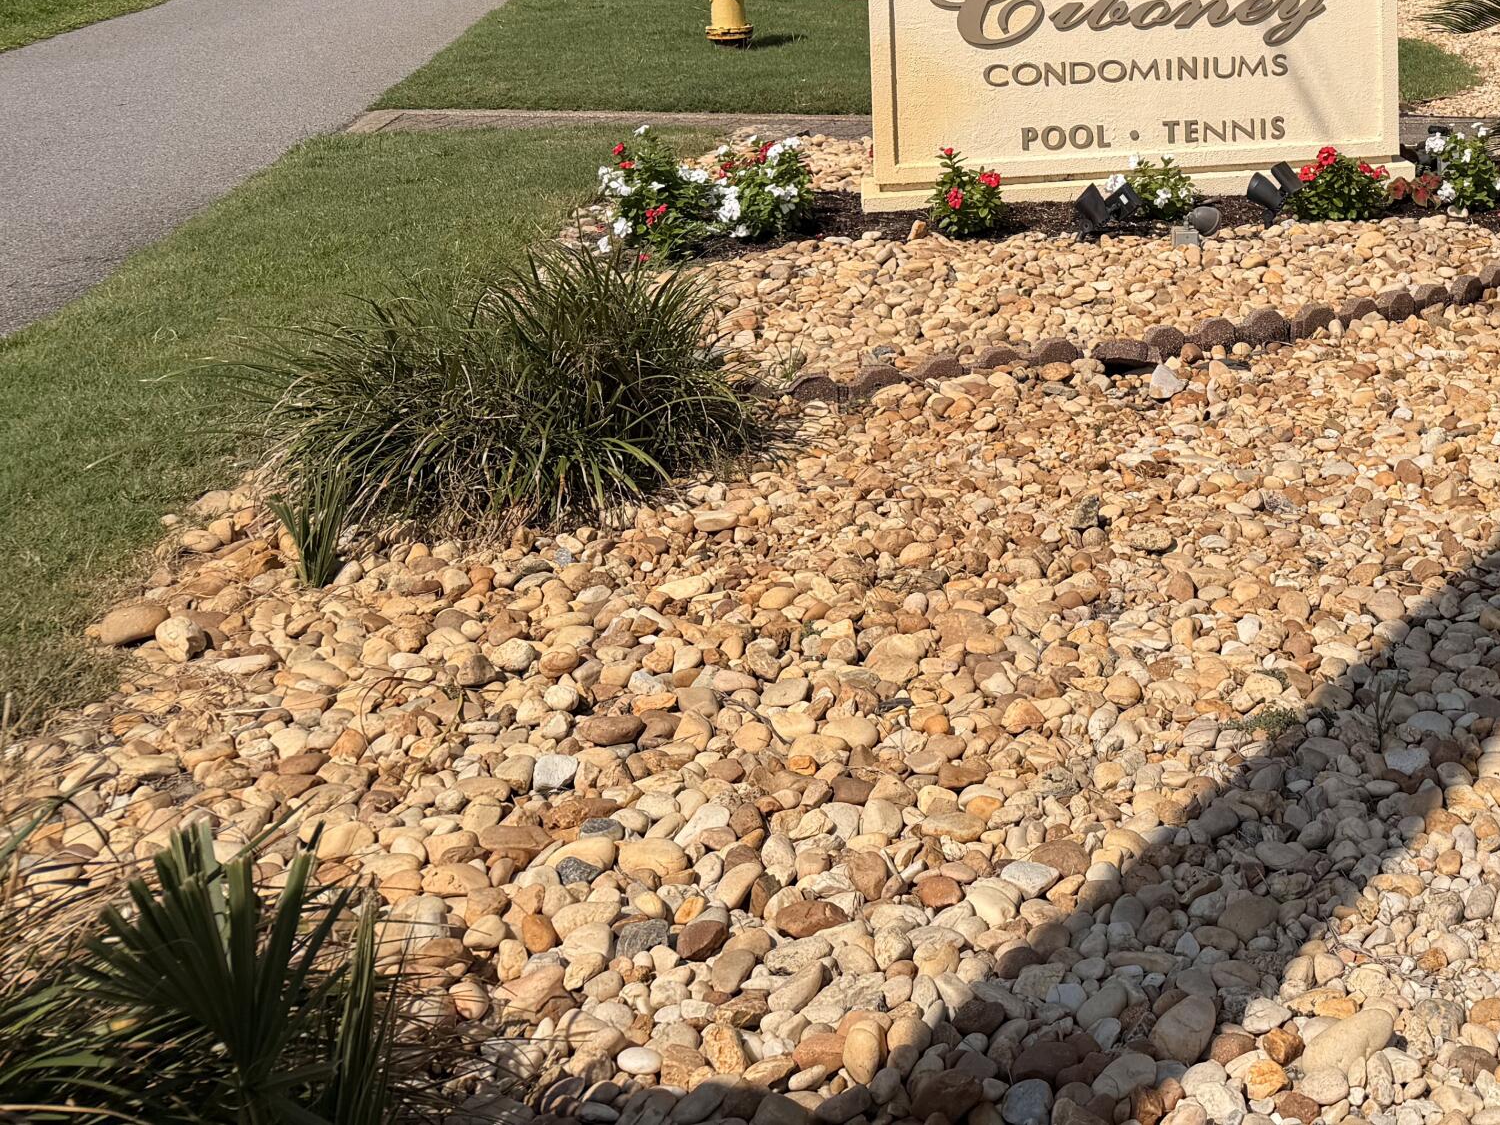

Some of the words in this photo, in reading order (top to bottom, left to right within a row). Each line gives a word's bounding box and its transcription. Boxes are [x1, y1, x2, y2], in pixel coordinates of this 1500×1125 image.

[983, 53, 1289, 88] CONDOMINIUMS
[1021, 124, 1112, 151] POOL
[1162, 116, 1286, 144] TENNIS
